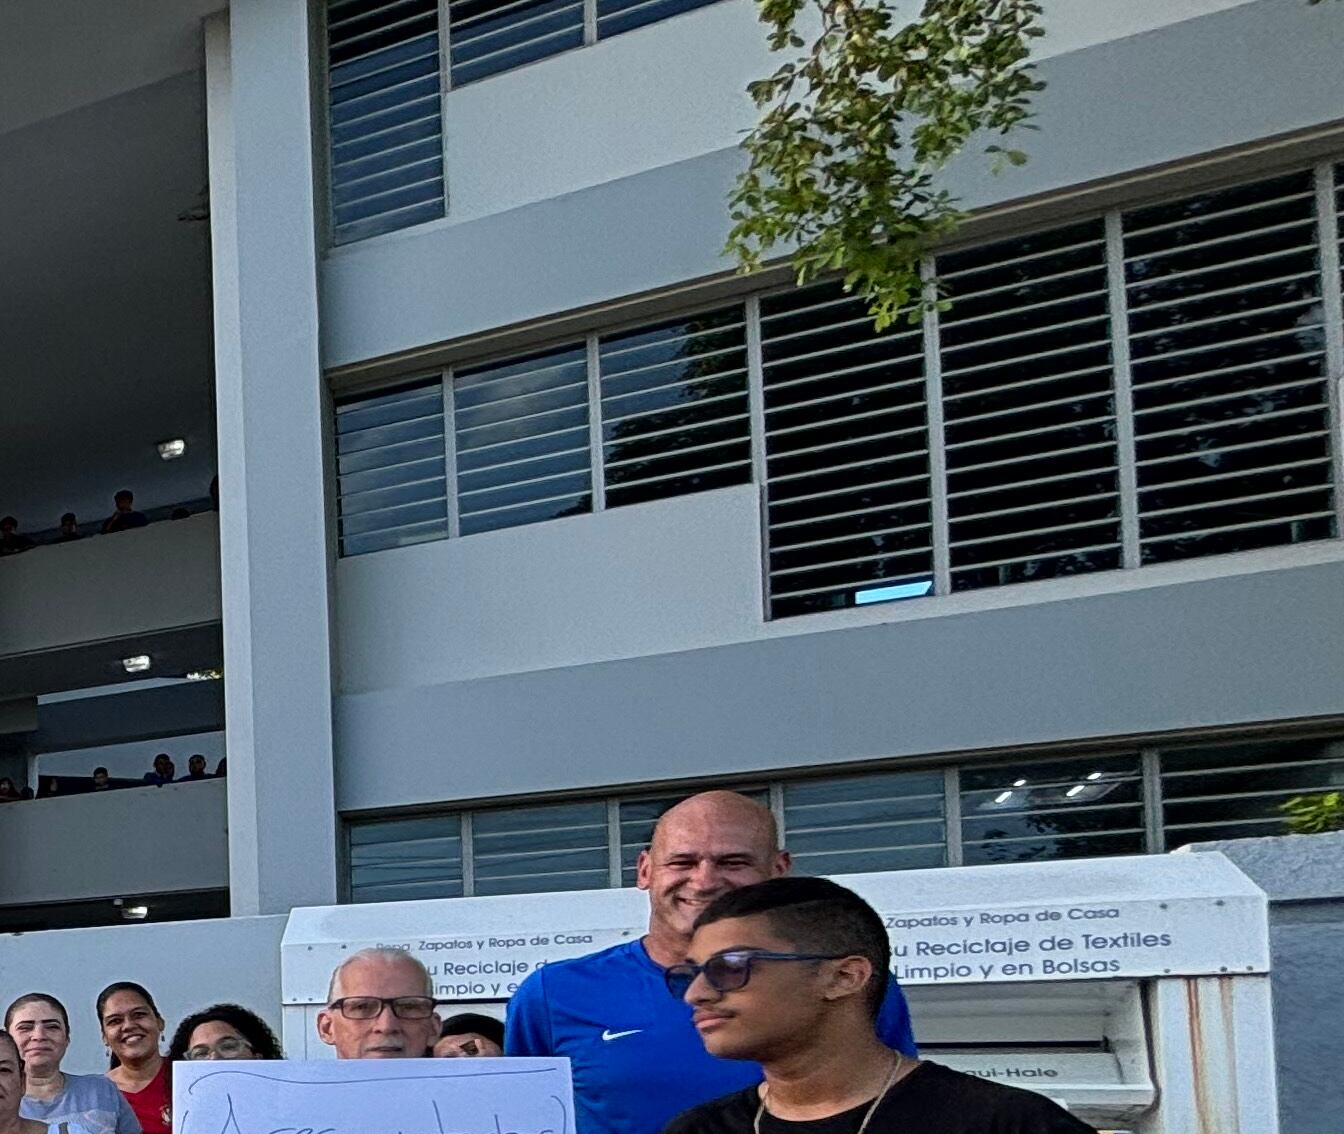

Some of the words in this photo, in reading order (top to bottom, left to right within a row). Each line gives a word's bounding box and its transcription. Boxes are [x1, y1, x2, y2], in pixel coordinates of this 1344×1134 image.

[885, 914, 959, 930] Zapatos
[962, 915, 975, 928] y
[979, 911, 1030, 927] Ropa
[1035, 908, 1062, 922] de
[1067, 907, 1120, 921] Casa
[418, 939, 473, 953] Zapatos
[476, 938, 485, 951] y
[488, 936, 526, 949] Ropa
[529, 934, 550, 946] de
[553, 933, 594, 946] Casa
[888, 942, 908, 957] u
[915, 936, 1031, 958] Reciclaje
[1038, 934, 1075, 952] de
[1082, 932, 1173, 950] Textiles
[427, 964, 438, 976] u
[443, 958, 529, 980] Reciclaje
[892, 962, 973, 982] Limpio
[979, 964, 995, 979] y
[1001, 960, 1034, 976] en
[1042, 957, 1122, 975] Bolsas
[434, 981, 486, 996] impio
[490, 983, 501, 996] y
